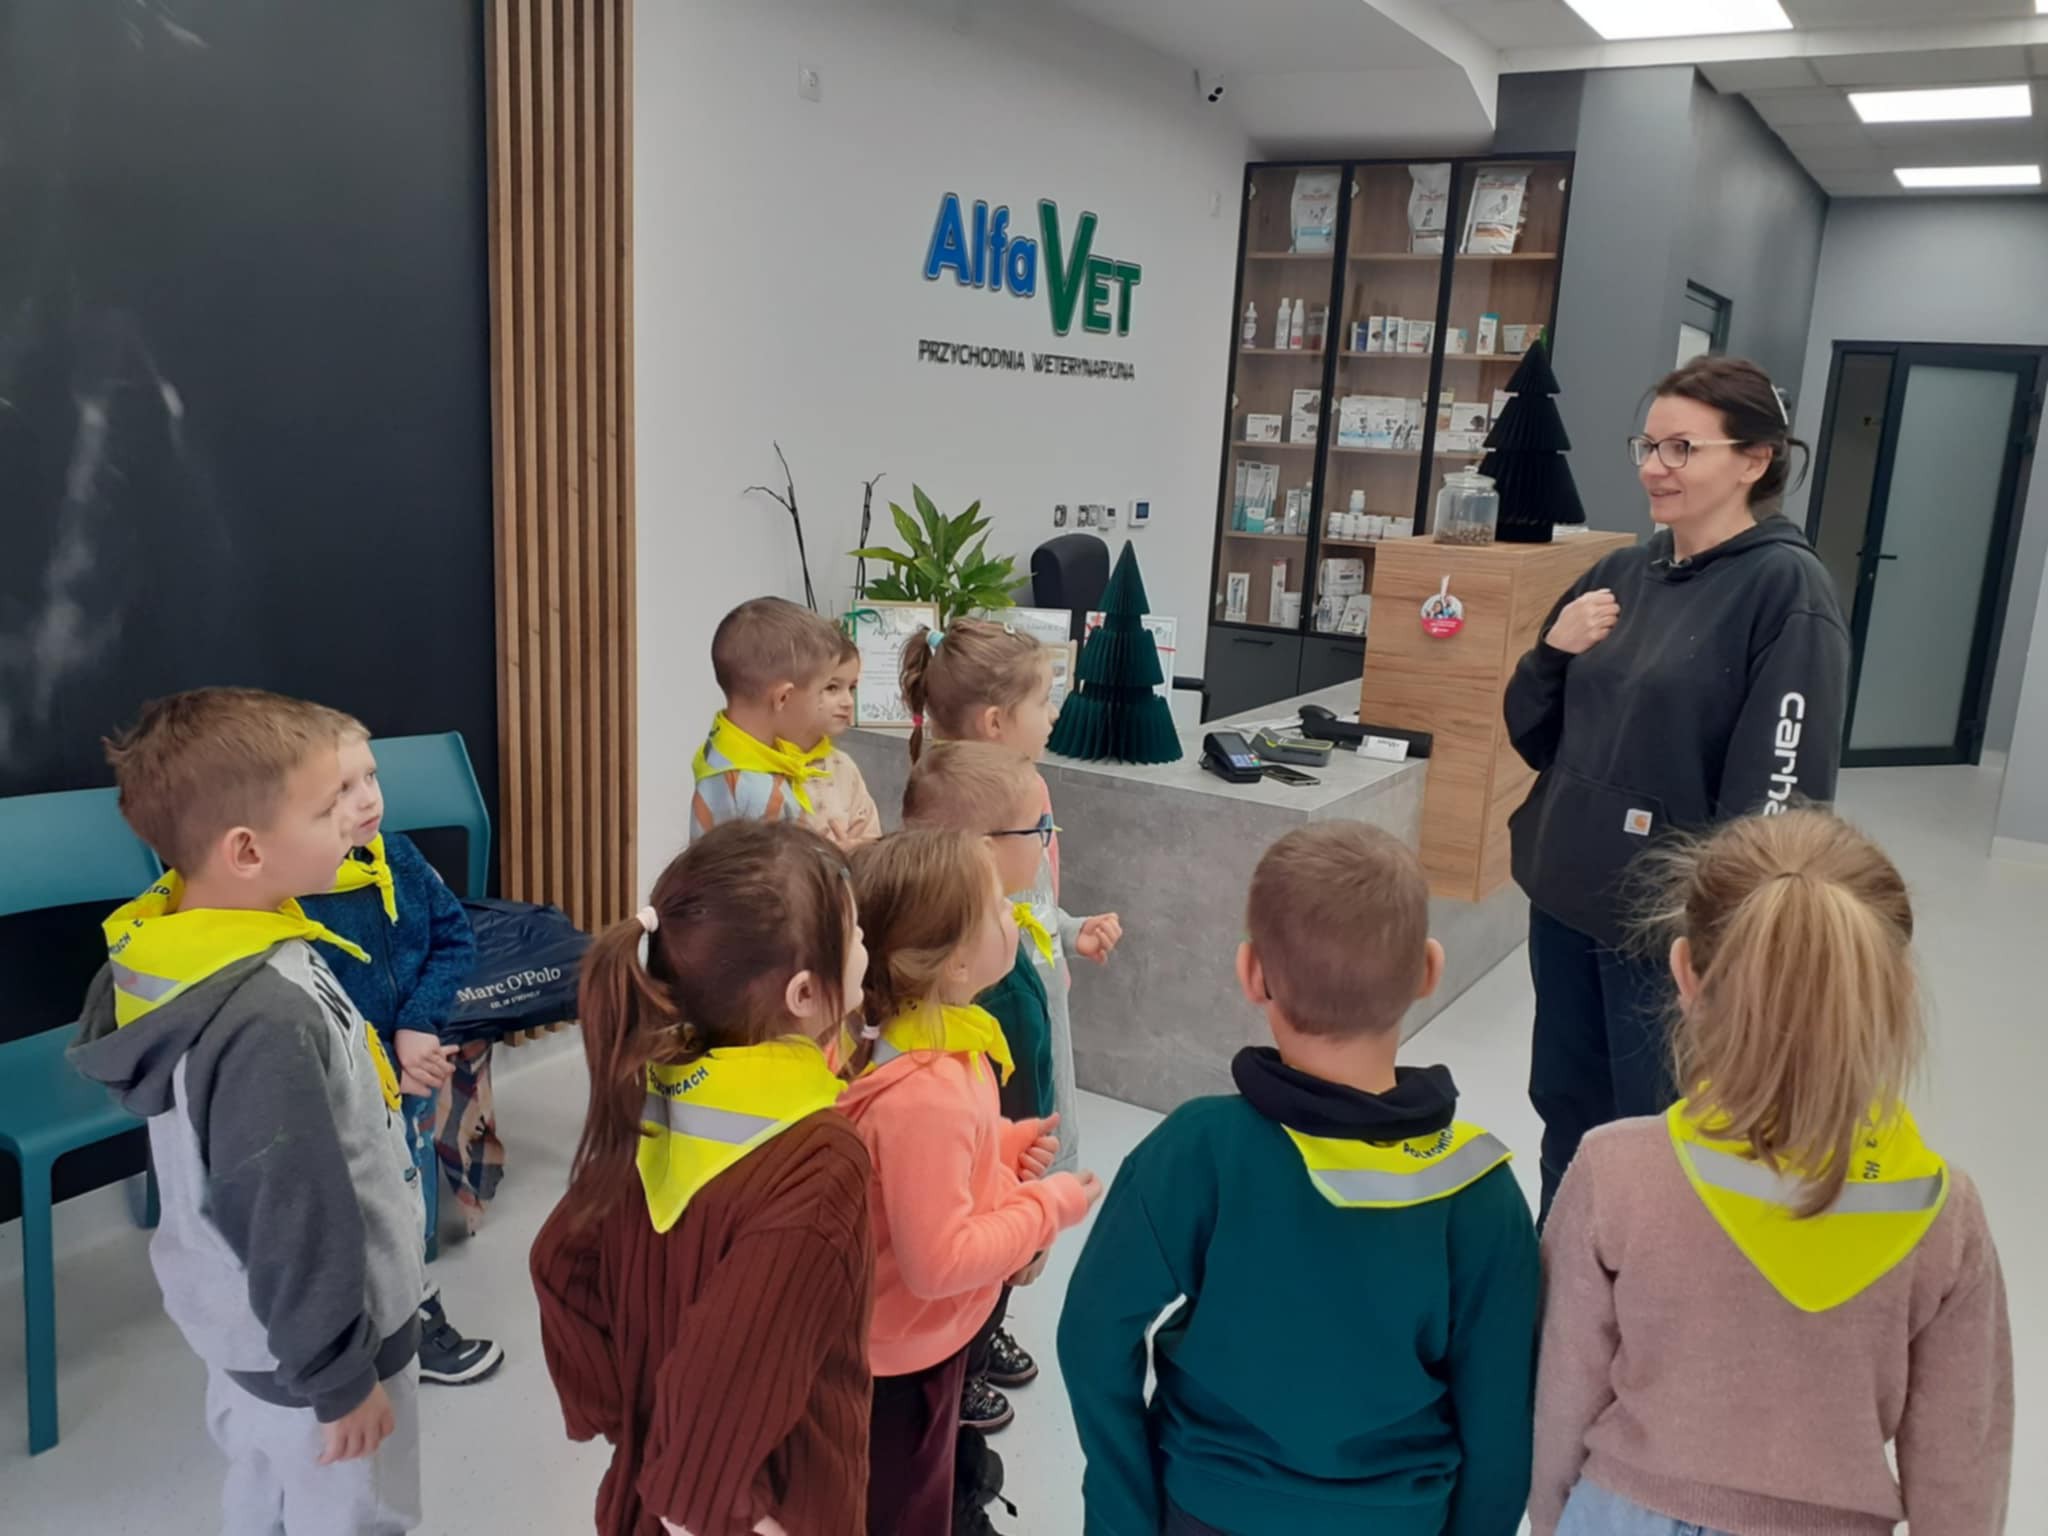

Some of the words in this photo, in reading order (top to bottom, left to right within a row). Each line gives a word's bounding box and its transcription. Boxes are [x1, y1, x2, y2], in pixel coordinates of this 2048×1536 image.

[918, 339, 1026, 373] PRZYCHODNIA
[1031, 352, 1136, 381] WETERYNARYJNA
[456, 981, 507, 1003] Marc
[506, 966, 562, 991] O'Polo
